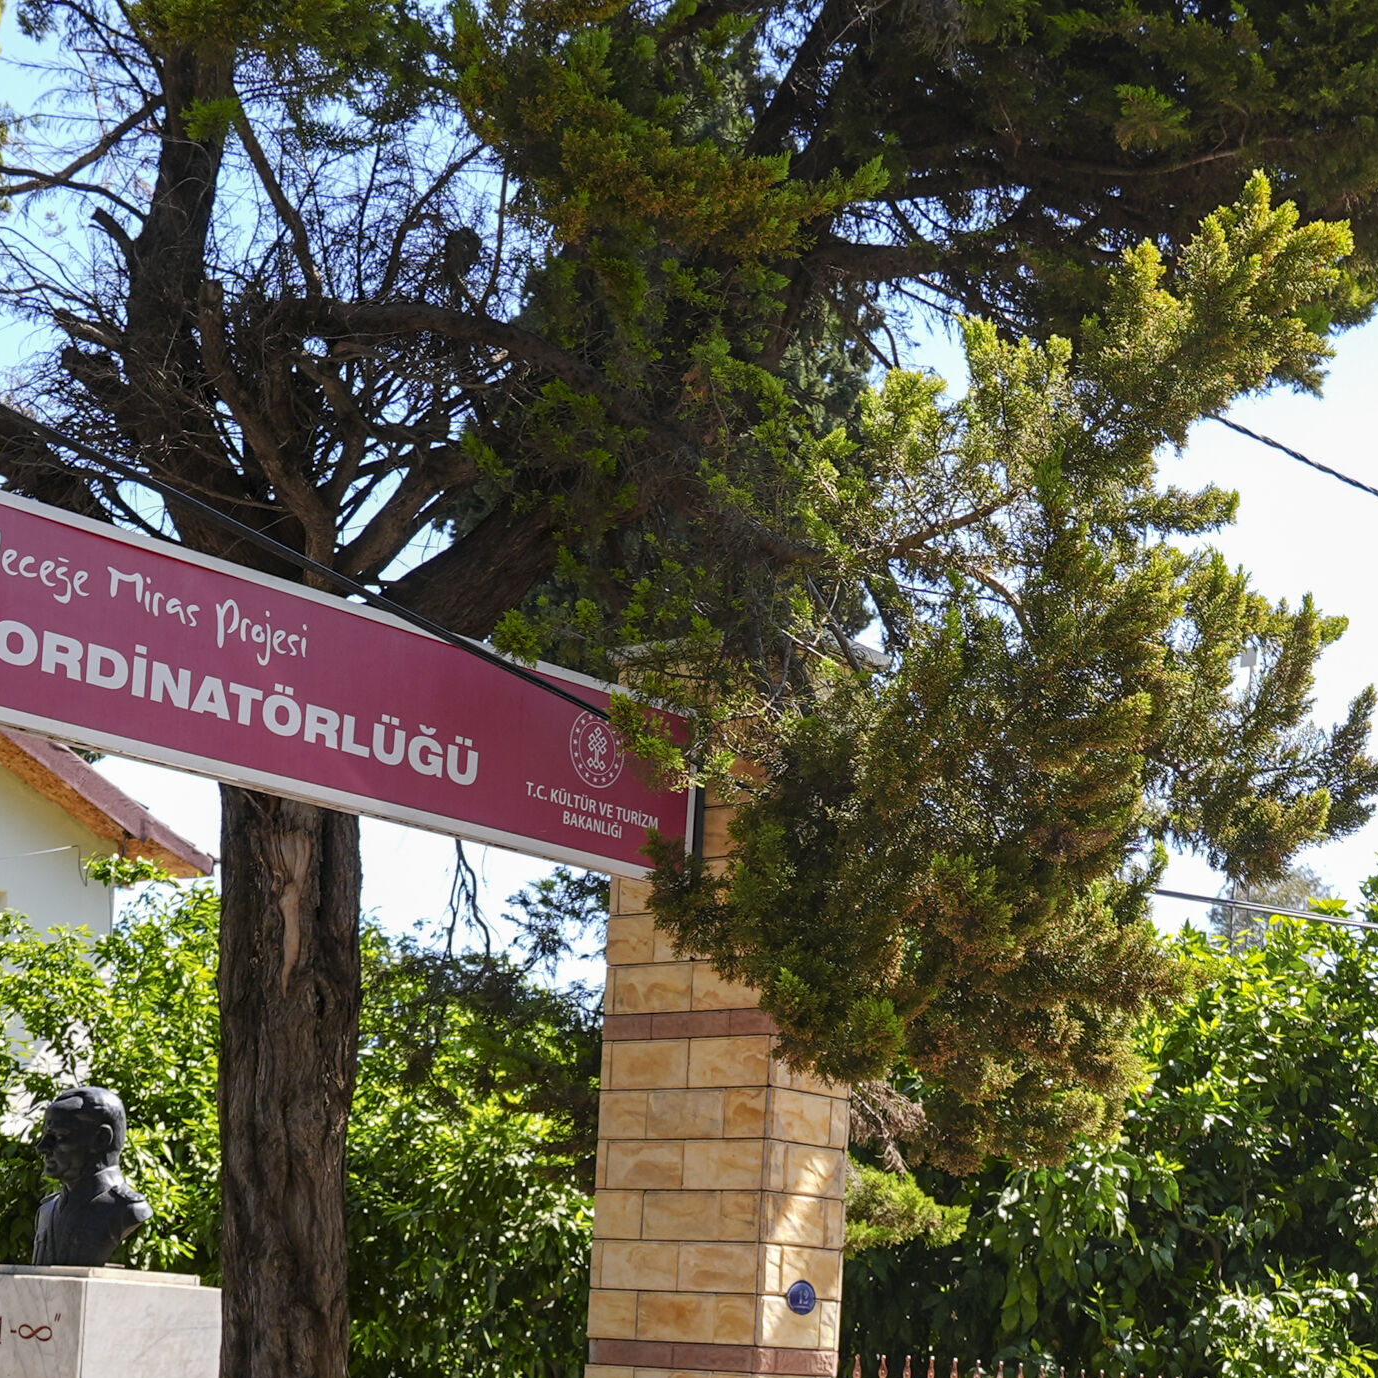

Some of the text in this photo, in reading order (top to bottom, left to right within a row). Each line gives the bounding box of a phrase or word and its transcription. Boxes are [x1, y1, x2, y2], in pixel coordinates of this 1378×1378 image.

[107, 566, 200, 627] Miras
[216, 599, 309, 667] Projesi
[526, 781, 659, 830] T.C. KÜLTÜR VE TURİZM
[562, 810, 623, 839] BAKANLIĞI
